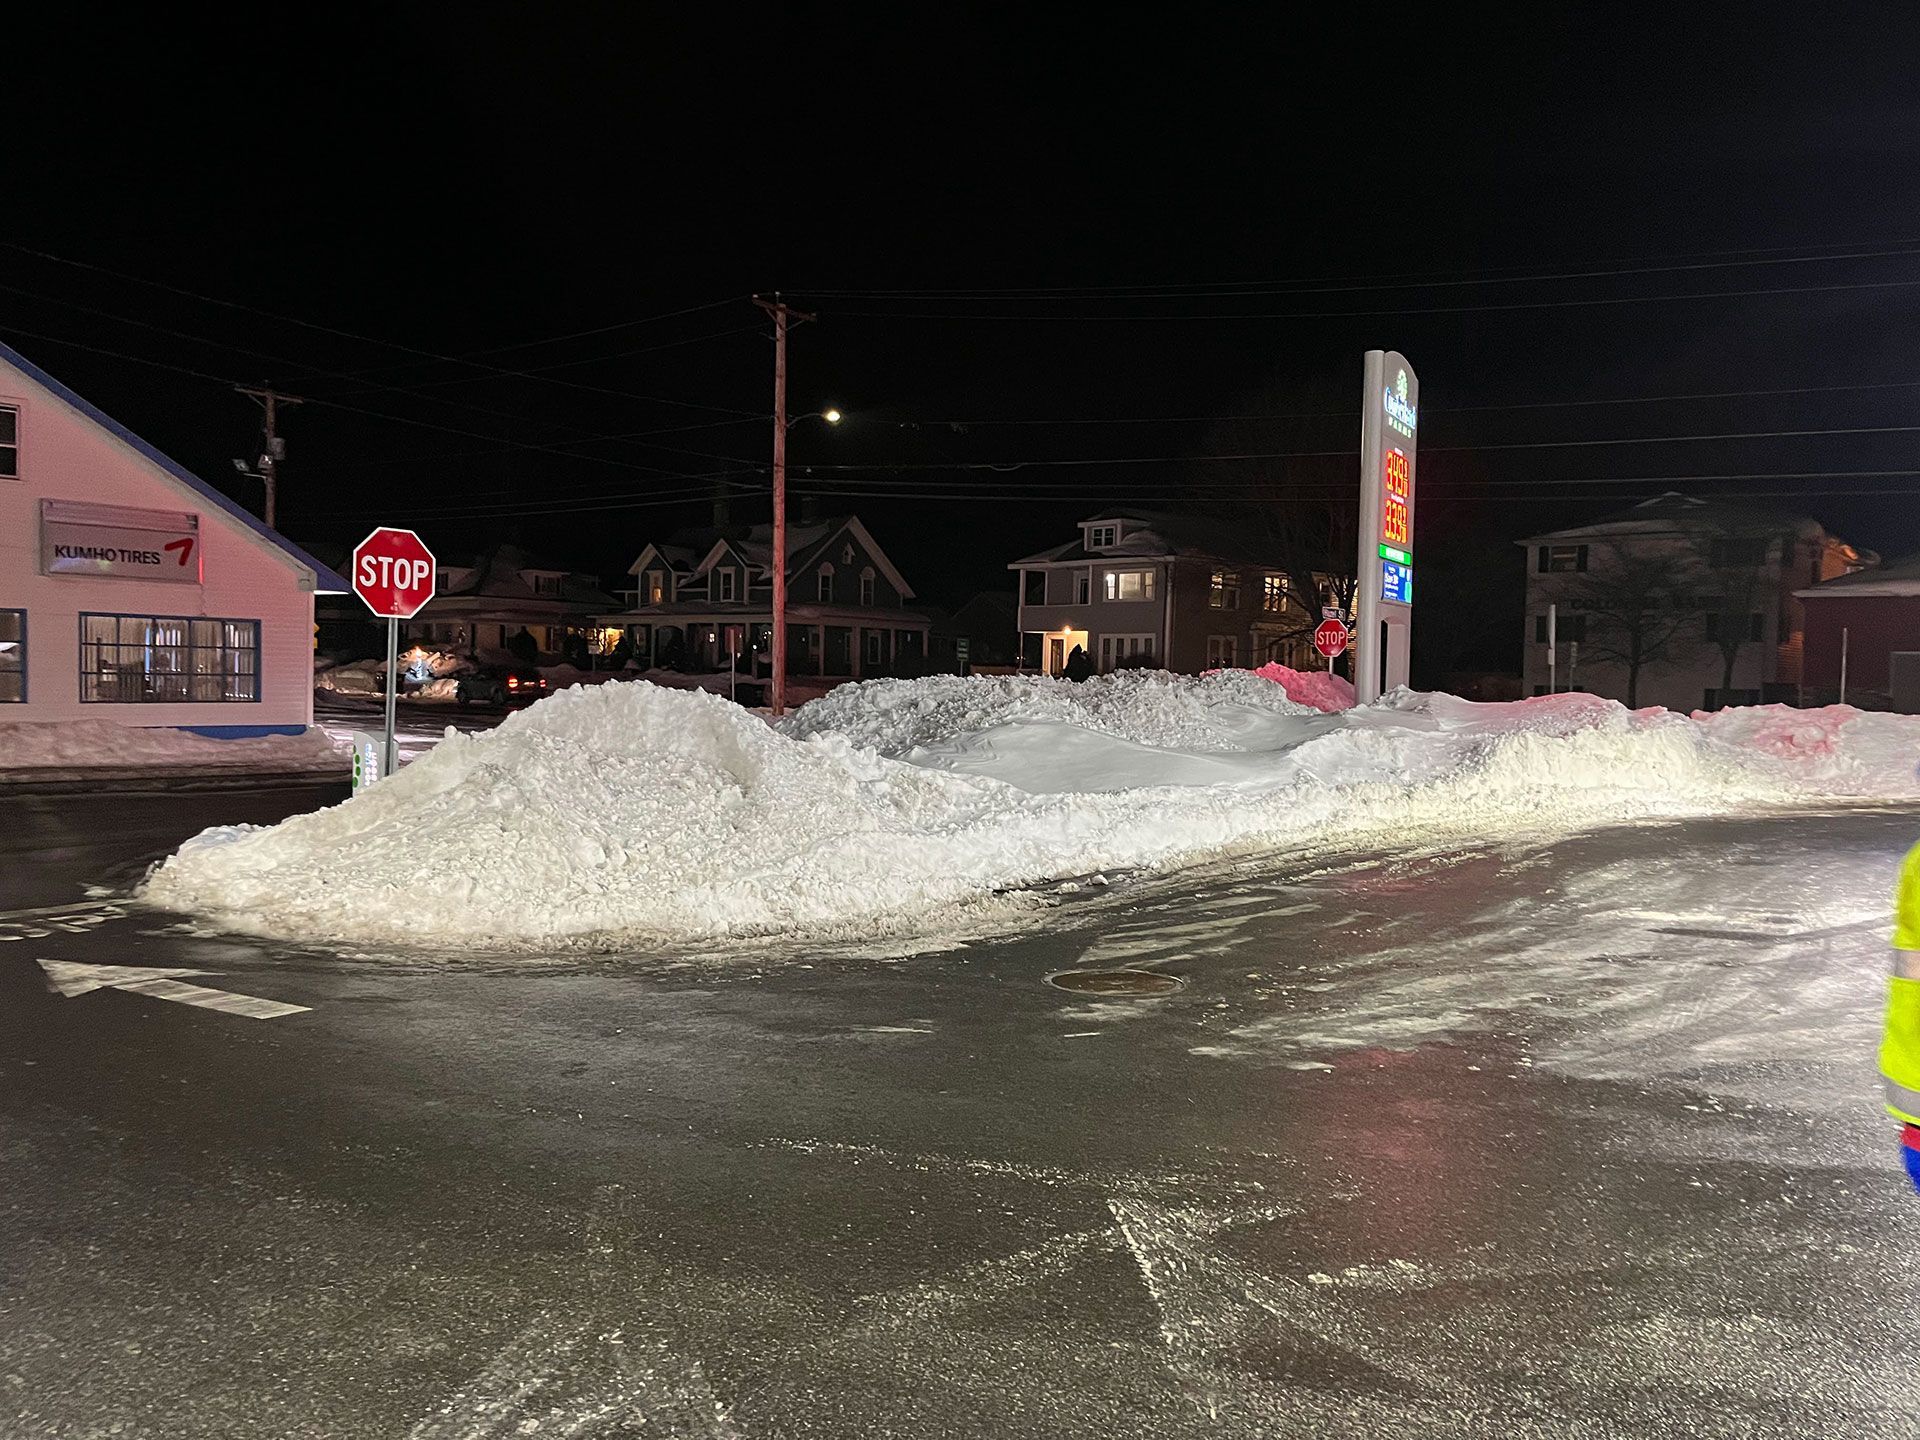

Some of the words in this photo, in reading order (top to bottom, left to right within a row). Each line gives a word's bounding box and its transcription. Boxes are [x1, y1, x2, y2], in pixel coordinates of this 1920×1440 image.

[55, 545, 116, 562] KUMHO
[120, 550, 161, 565] TIRES
[360, 555, 429, 590] STOP
[1317, 631, 1345, 645] STOP
